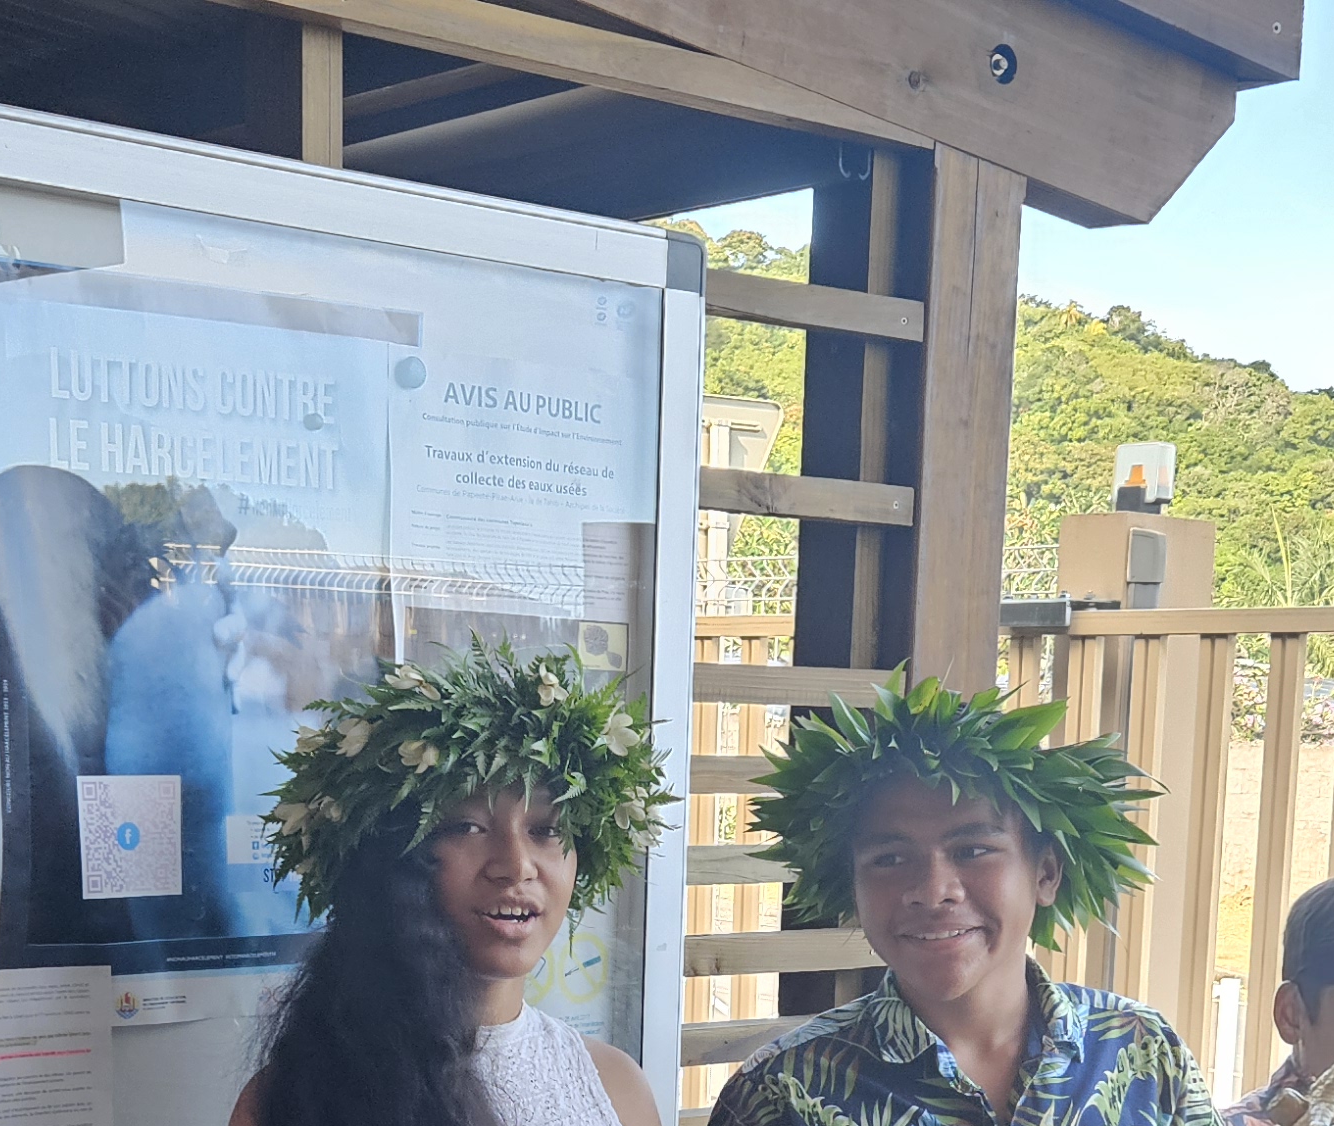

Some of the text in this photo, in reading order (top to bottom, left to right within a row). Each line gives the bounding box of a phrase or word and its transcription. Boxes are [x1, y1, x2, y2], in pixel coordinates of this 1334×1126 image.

[49, 346, 336, 425] LUTTONS CONTRE
[443, 381, 603, 425] AVIS AU PUBLIC
[422, 412, 465, 425] Consultation
[465, 418, 498, 430] publique
[49, 417, 90, 471] LE
[424, 444, 614, 480] Travaux d'extension du réseau de
[455, 472, 587, 497] collecte des eaux usées
